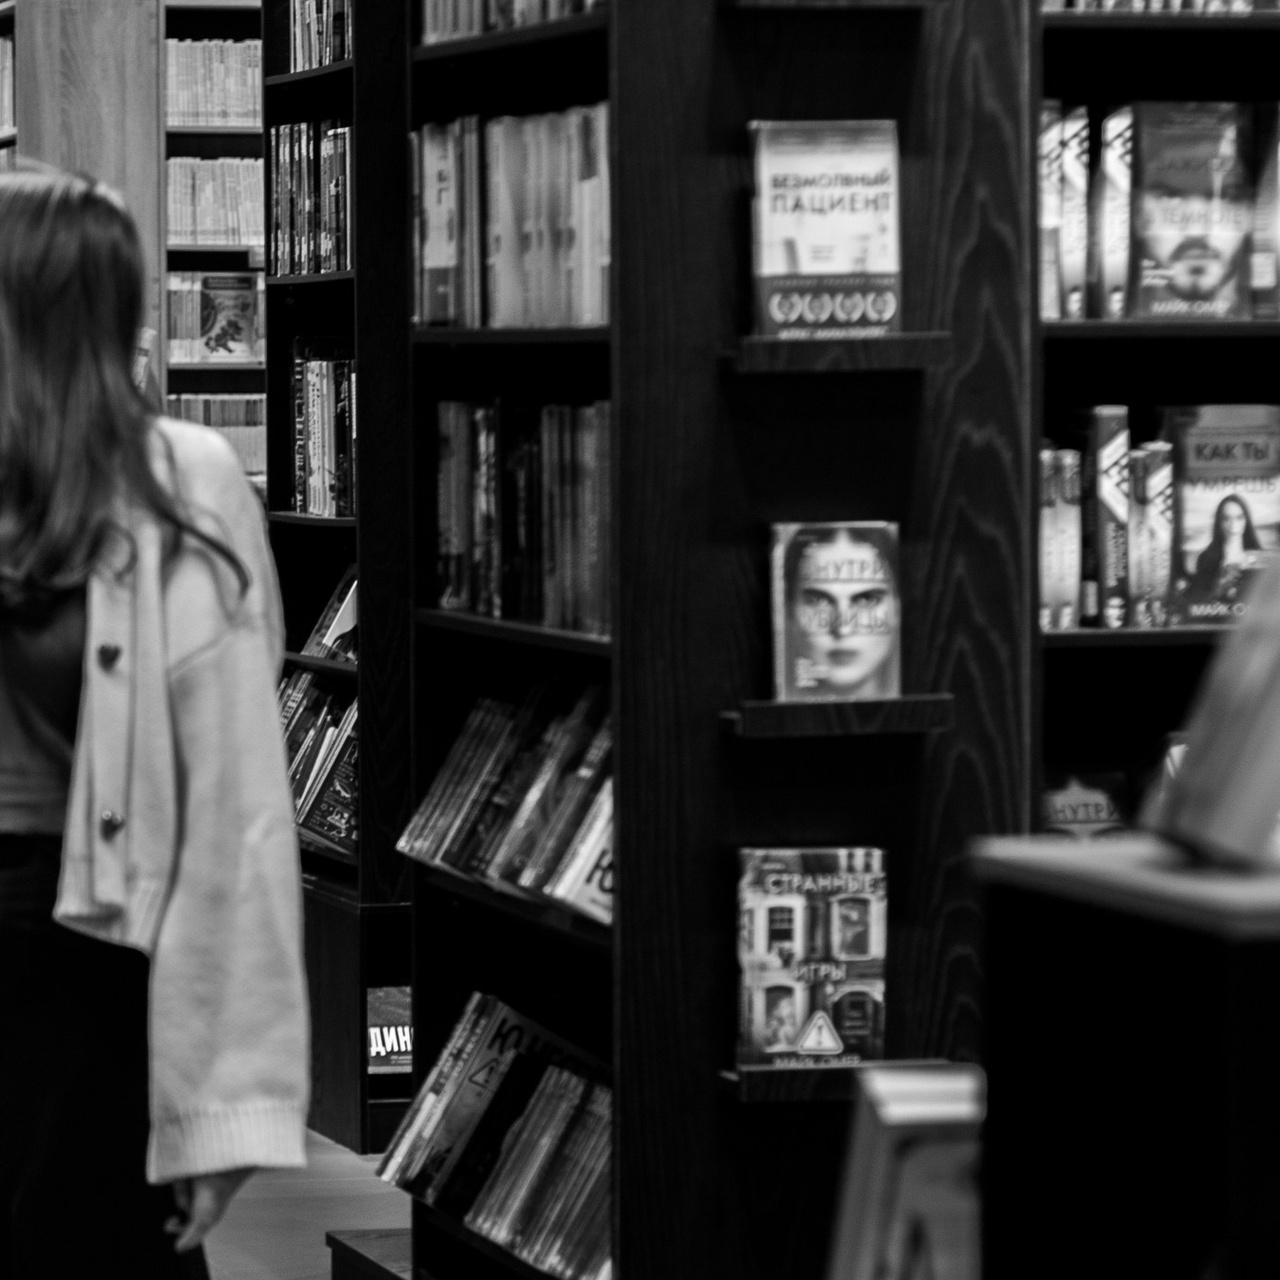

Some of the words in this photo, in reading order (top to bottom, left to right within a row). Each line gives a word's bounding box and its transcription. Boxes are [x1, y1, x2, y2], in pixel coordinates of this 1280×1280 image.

[771, 192, 892, 216] ПАЦИЕНТ
[1195, 442, 1237, 461] КАК
[1242, 442, 1269, 461] ТЫ
[763, 872, 878, 895] СТРАННЫЕ
[796, 962, 848, 981] ИГРЫ
[369, 1025, 414, 1057] ДИН
